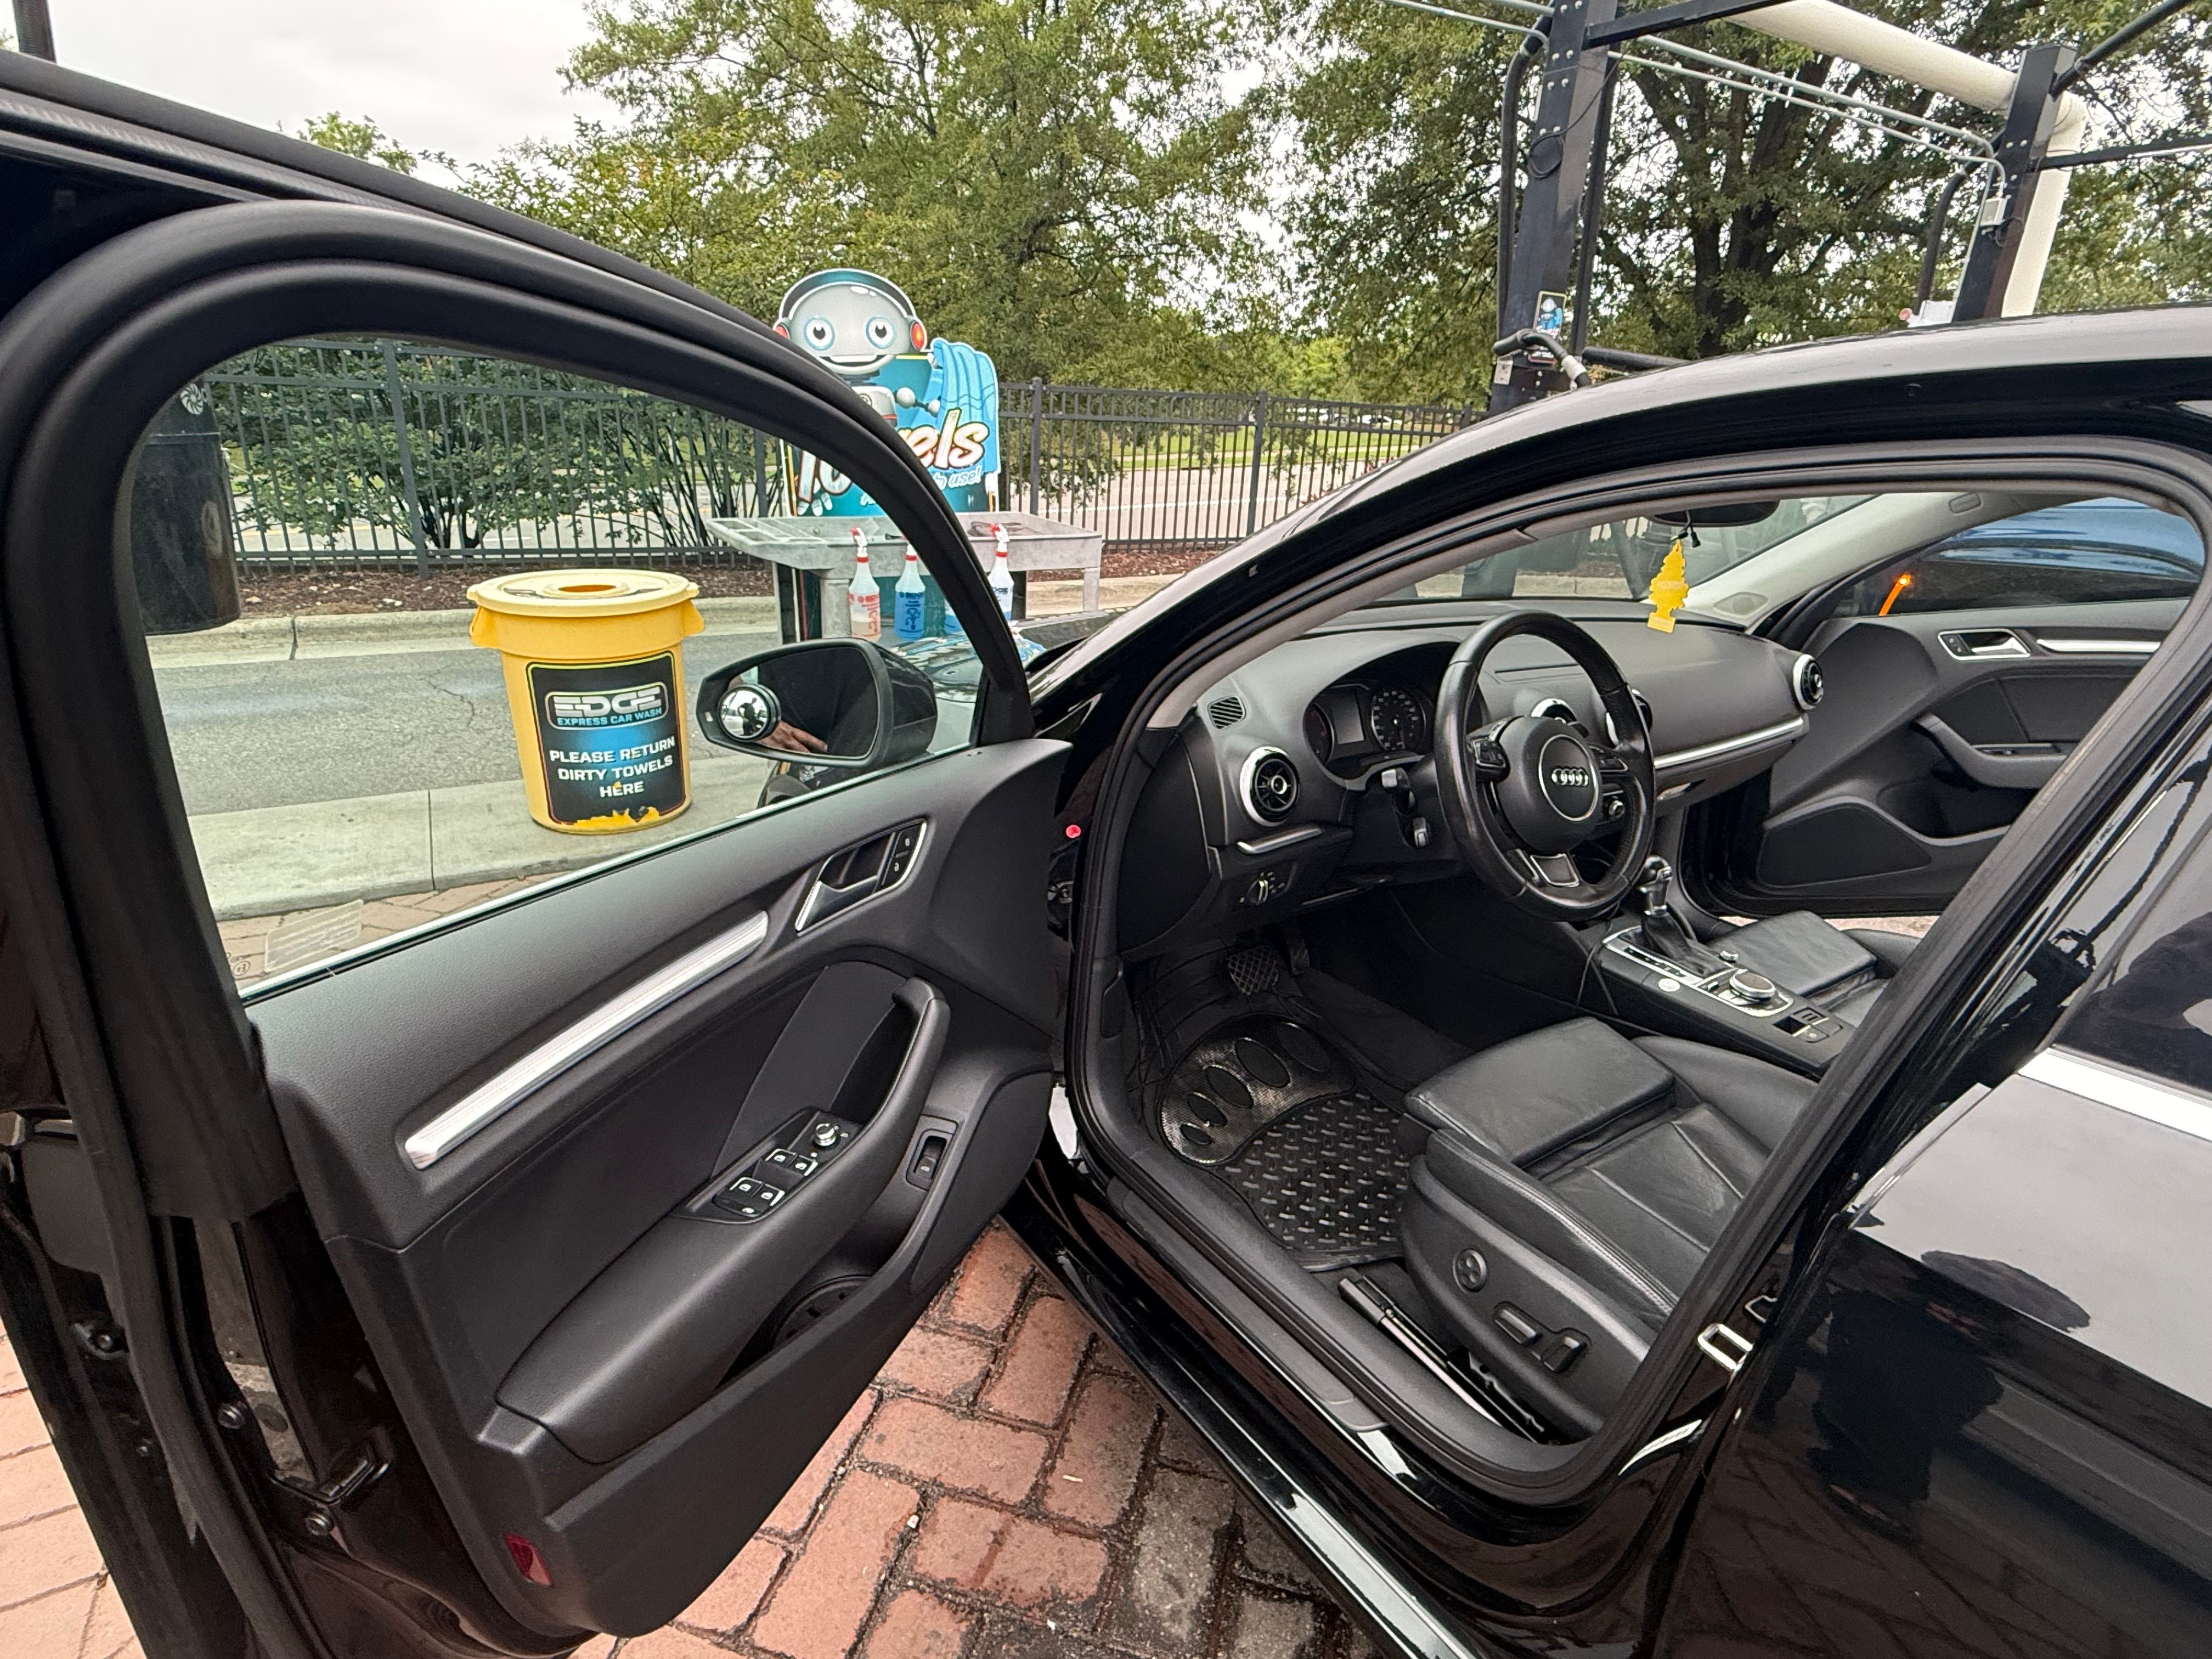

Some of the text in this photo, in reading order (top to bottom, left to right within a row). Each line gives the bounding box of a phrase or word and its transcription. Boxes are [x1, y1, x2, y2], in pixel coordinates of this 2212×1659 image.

[553, 686, 662, 718] EDGE
[557, 707, 662, 726] EXPRESS CAR WASH
[549, 735, 676, 764] PLEASE RETURN
[558, 754, 673, 781] DIRTY TOWELS
[599, 781, 645, 798] HERE
